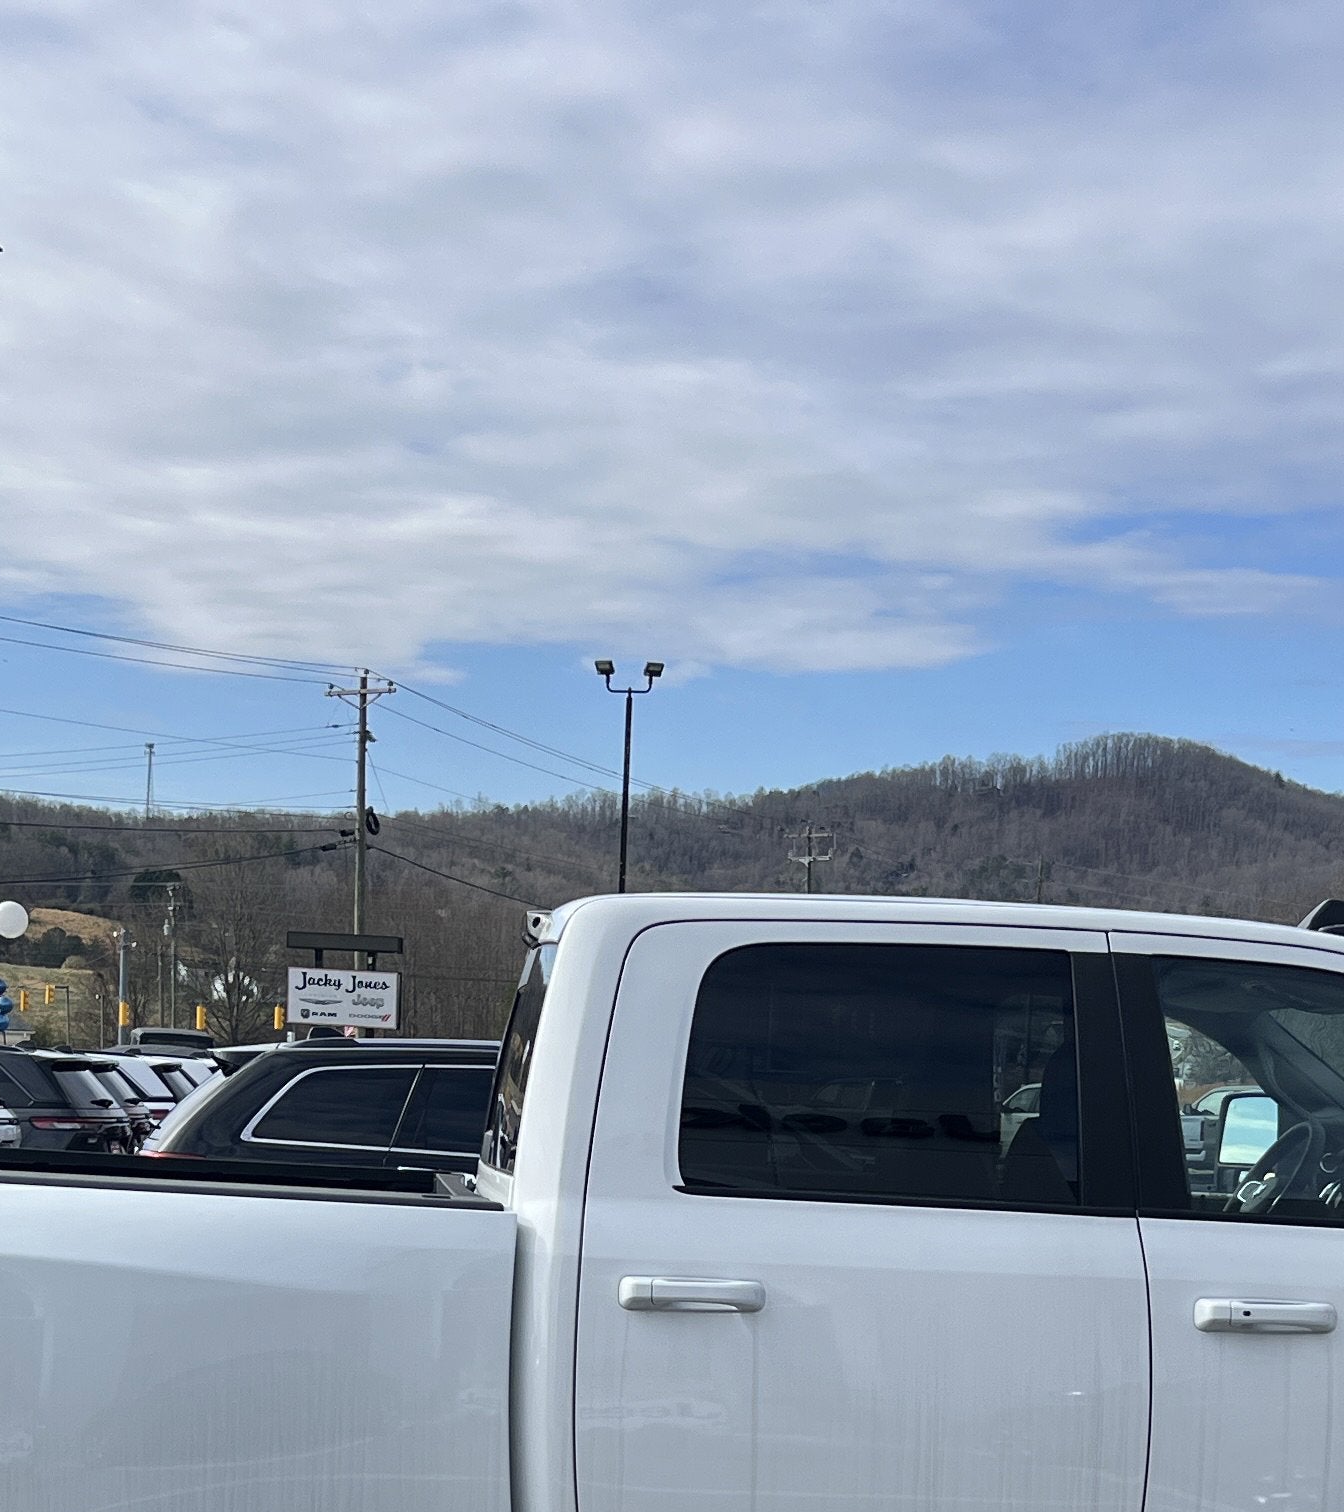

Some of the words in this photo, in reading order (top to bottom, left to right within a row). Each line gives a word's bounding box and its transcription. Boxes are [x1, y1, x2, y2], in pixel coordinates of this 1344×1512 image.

[295, 972, 343, 990] Jacky
[345, 975, 390, 993] Jones
[352, 994, 384, 1009] Jeep
